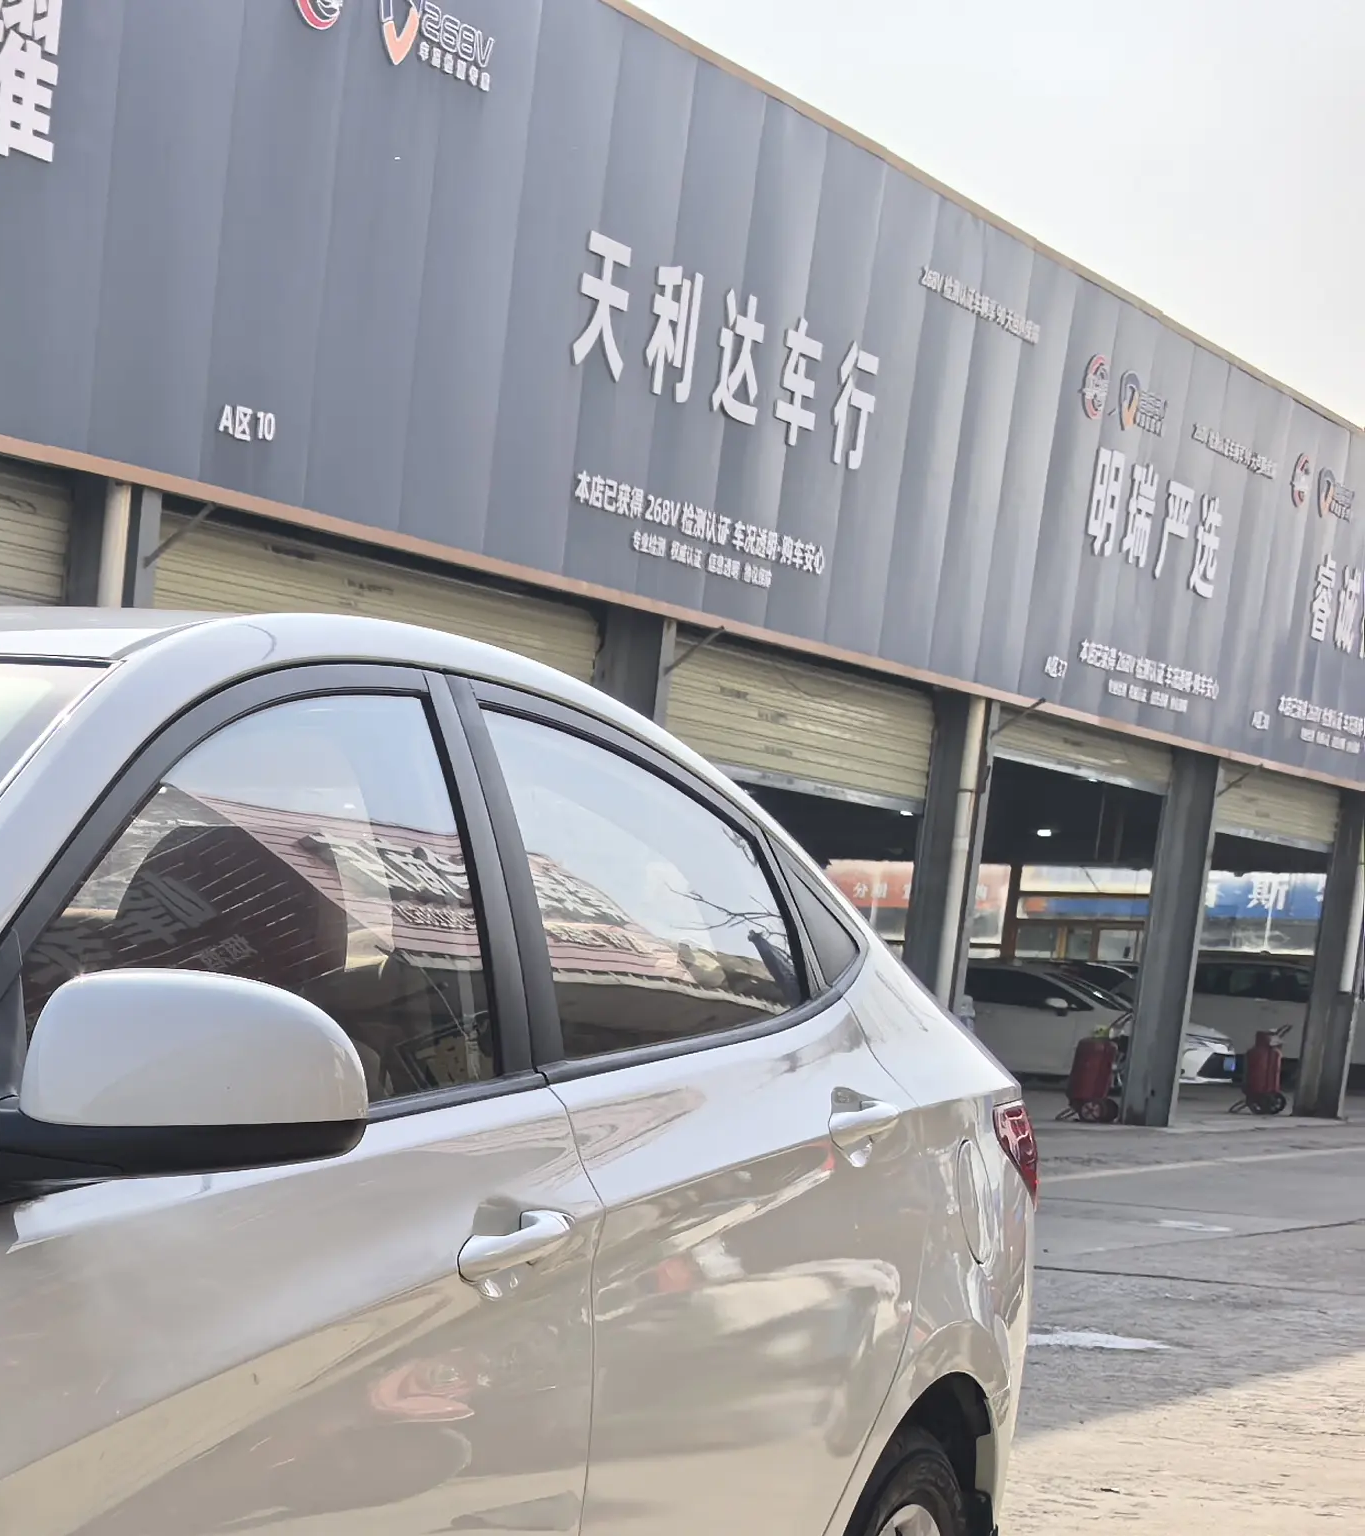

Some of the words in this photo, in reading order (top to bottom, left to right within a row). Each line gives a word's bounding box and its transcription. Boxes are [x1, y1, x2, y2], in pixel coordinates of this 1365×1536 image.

[572, 230, 879, 470] 天利达车行
[219, 405, 252, 441] A区
[256, 412, 276, 442] 10
[574, 470, 644, 518] 本店已获得
[645, 494, 681, 528] 268V
[681, 501, 732, 546] 检测认证
[1087, 446, 1223, 599] 明瑞严选
